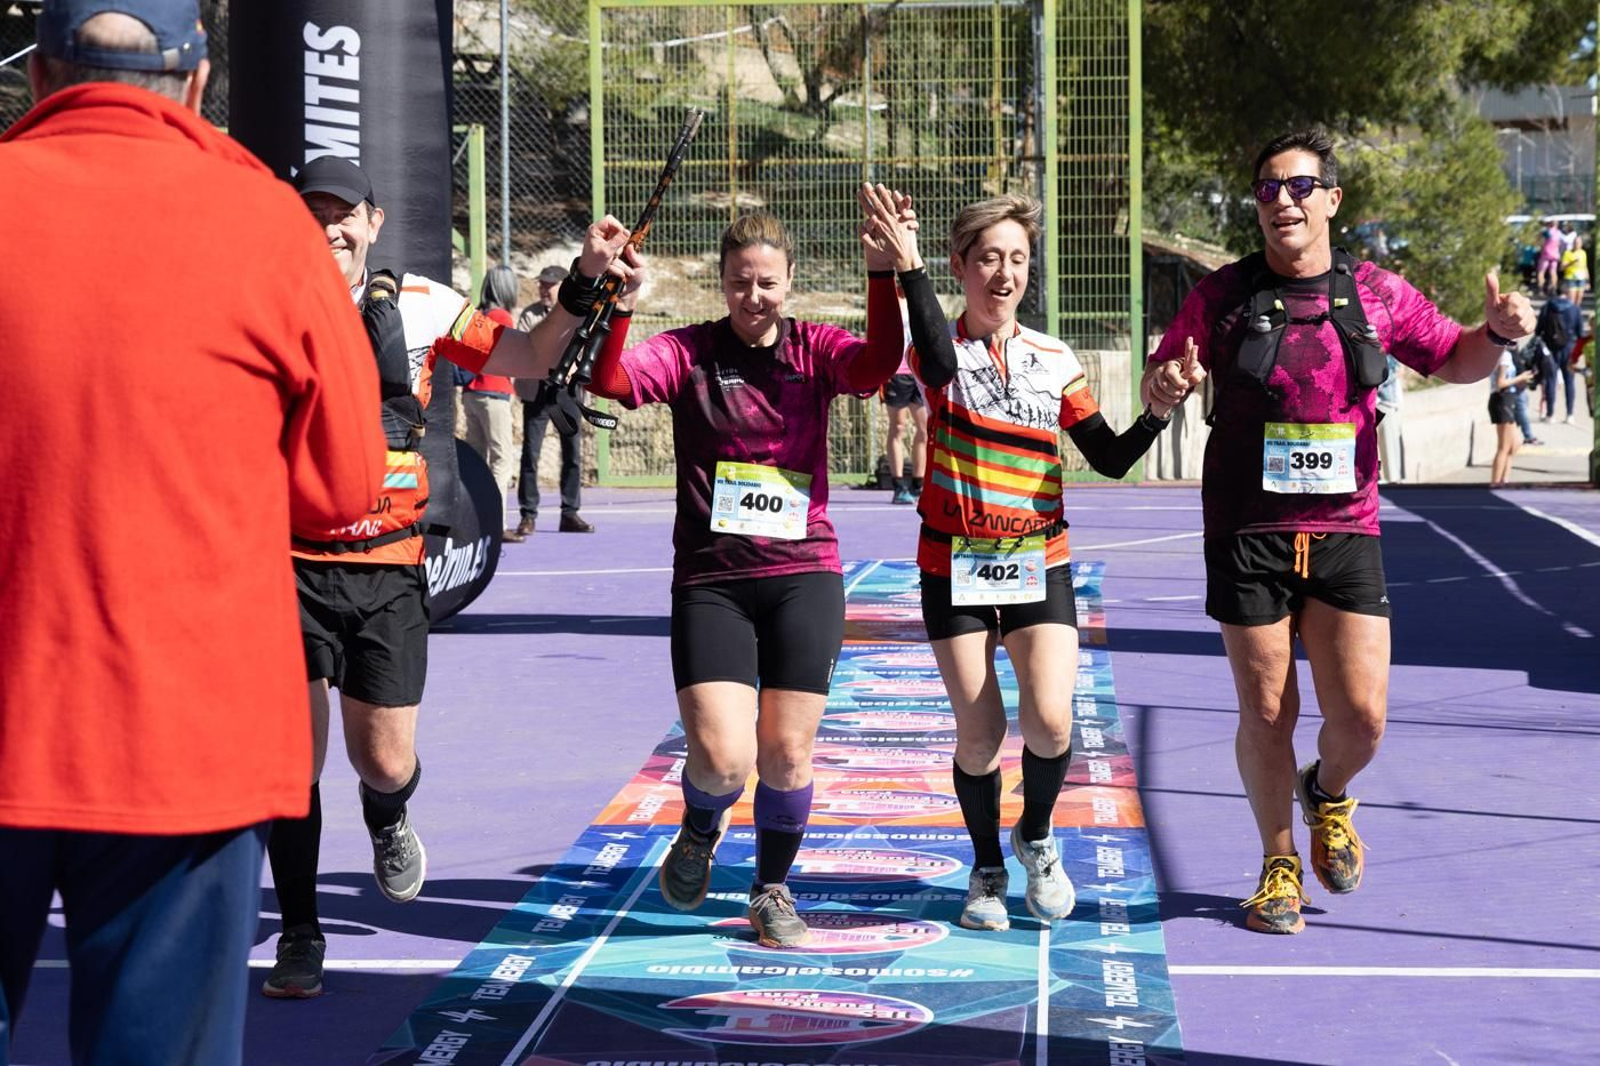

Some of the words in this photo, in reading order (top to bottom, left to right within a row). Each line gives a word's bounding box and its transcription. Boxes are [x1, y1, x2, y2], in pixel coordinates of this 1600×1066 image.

[303, 21, 361, 167] MITES
[1291, 451, 1333, 470] 399
[740, 492, 784, 513] 400
[977, 563, 1019, 581] 402
[470, 953, 537, 1002] TEAMERGY
[647, 964, 974, 978] #somoselcambio
[1102, 959, 1139, 1008] TEAMERGY
